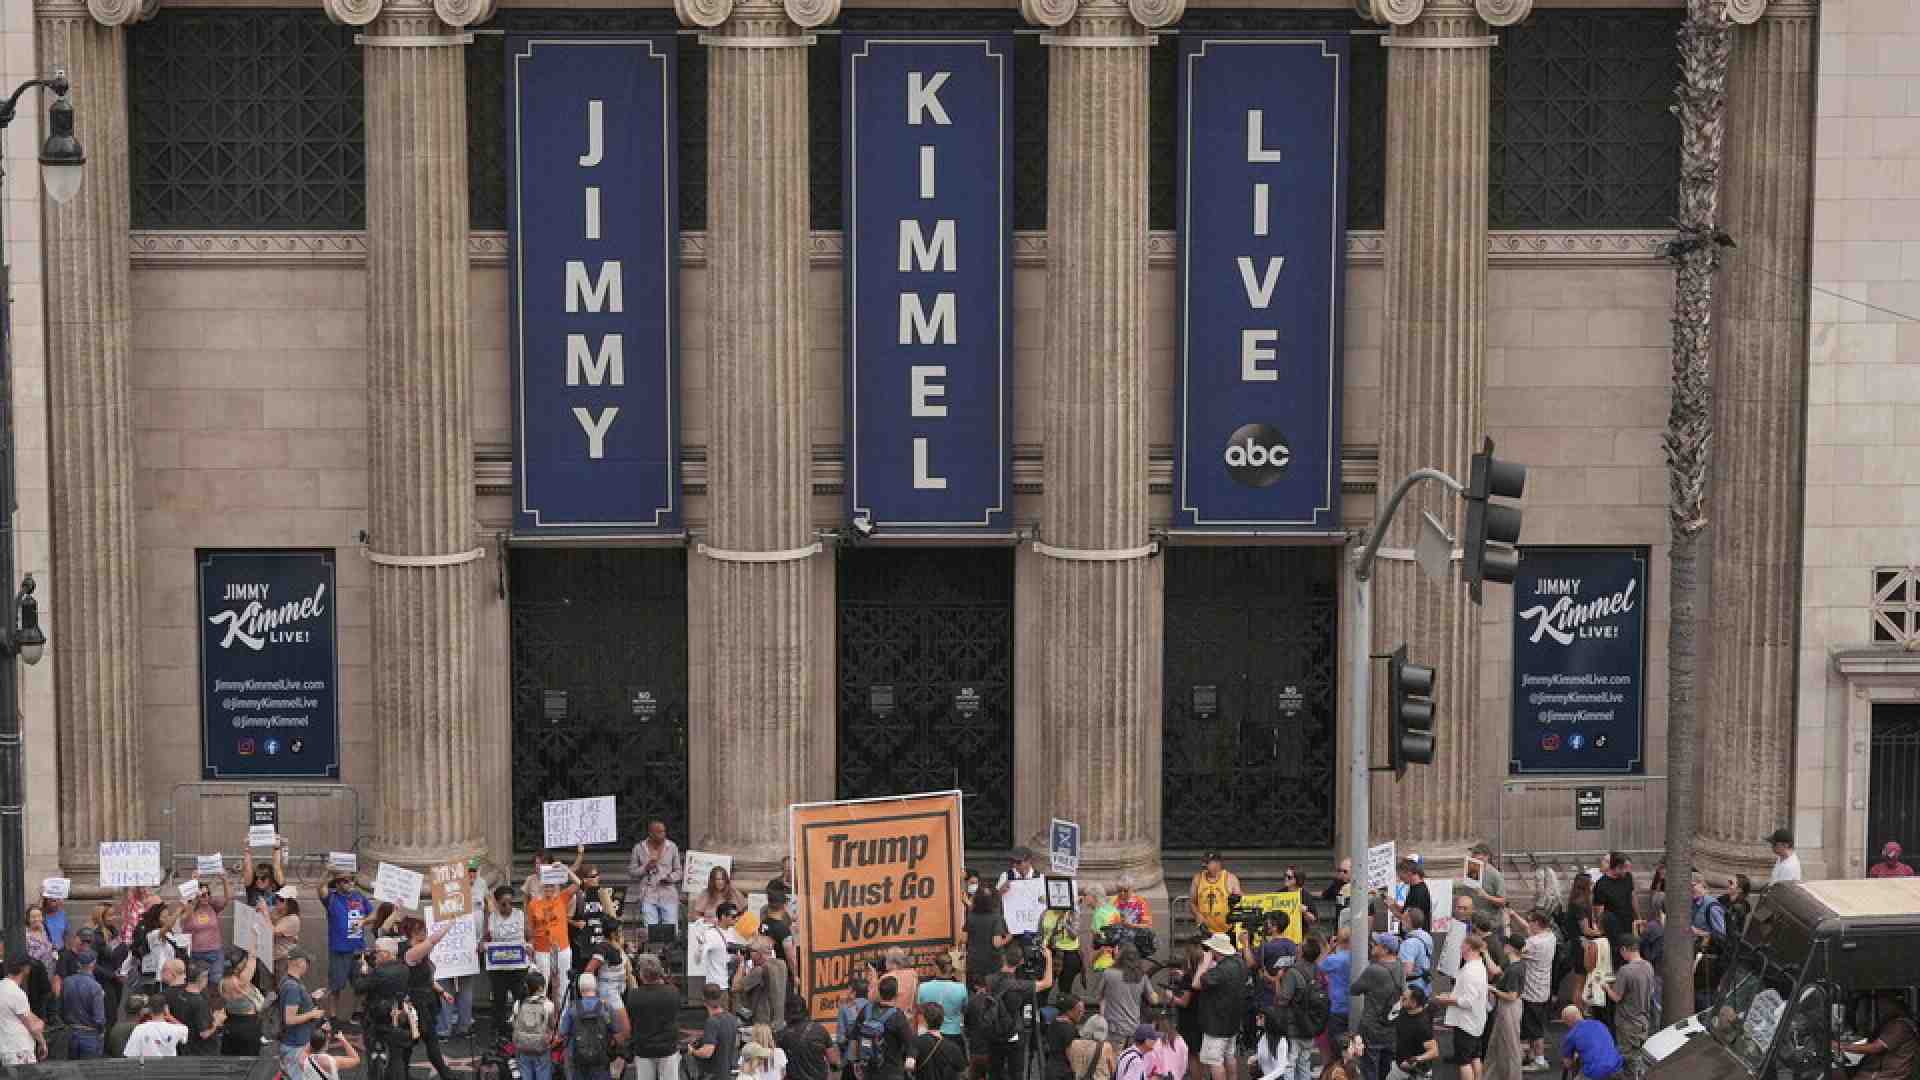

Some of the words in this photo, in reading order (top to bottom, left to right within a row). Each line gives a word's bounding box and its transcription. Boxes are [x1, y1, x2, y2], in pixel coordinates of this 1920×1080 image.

[1237, 110, 1284, 381] LIVE
[565, 100, 624, 459] JIMMY
[900, 72, 956, 489] KIMMEL
[1225, 437, 1289, 468] abc
[224, 584, 269, 601] JIMMY
[1535, 578, 1580, 595] JIMMY
[208, 583, 325, 651] Kimmel
[1519, 578, 1637, 645] Kimmel
[270, 631, 309, 643] LIVE!
[1579, 625, 1618, 639] LIVE!
[826, 833, 929, 870] Trump
[823, 875, 894, 910] Must
[899, 871, 935, 901] Go
[839, 906, 918, 943] Now!
[815, 954, 849, 989] NO!
